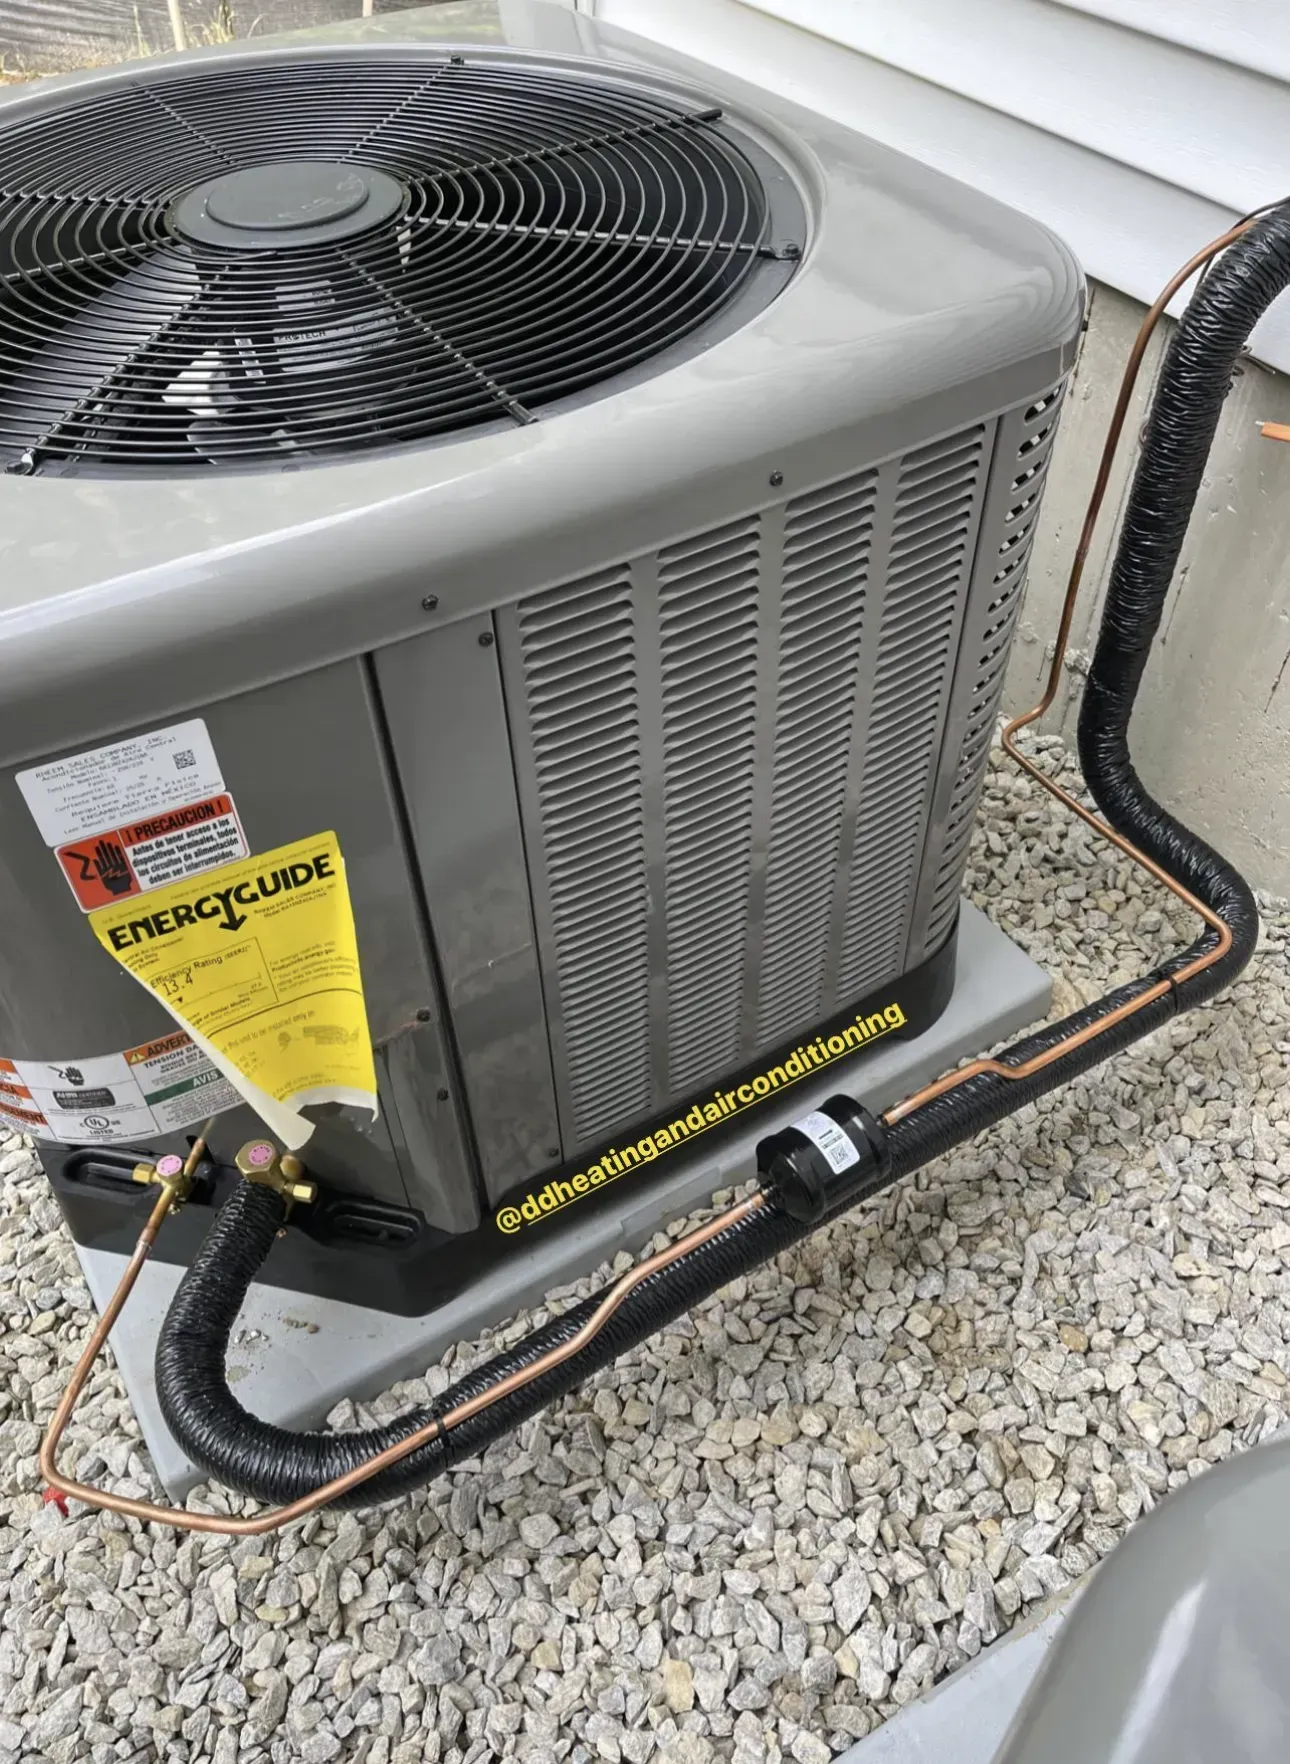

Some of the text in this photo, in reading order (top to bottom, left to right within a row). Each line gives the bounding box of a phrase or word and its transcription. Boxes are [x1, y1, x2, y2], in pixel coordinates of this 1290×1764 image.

[145, 737, 176, 750] Central
[35, 766, 64, 778] RHEEM
[68, 757, 95, 768] SALES
[81, 800, 140, 822] ENSAMBLADO
[134, 803, 215, 840] PRECAUCION
[132, 844, 154, 856] Antes
[155, 839, 164, 849] de
[165, 833, 184, 845] tener
[186, 825, 211, 839] acceso
[218, 817, 230, 827] los
[132, 827, 237, 868] dispositivos terminales, todos
[137, 837, 239, 877] los circuitos de alimentación
[149, 872, 171, 884] deben
[172, 867, 183, 876] ser
[184, 850, 237, 872] interrumpidos.
[107, 853, 335, 951] ENERGYGUIDE
[150, 966, 192, 988] Efficiency
[193, 955, 223, 970] Rating
[162, 972, 193, 996] 13.4
[144, 1050, 184, 1068] TENSION
[193, 1071, 220, 1087] AVIS
